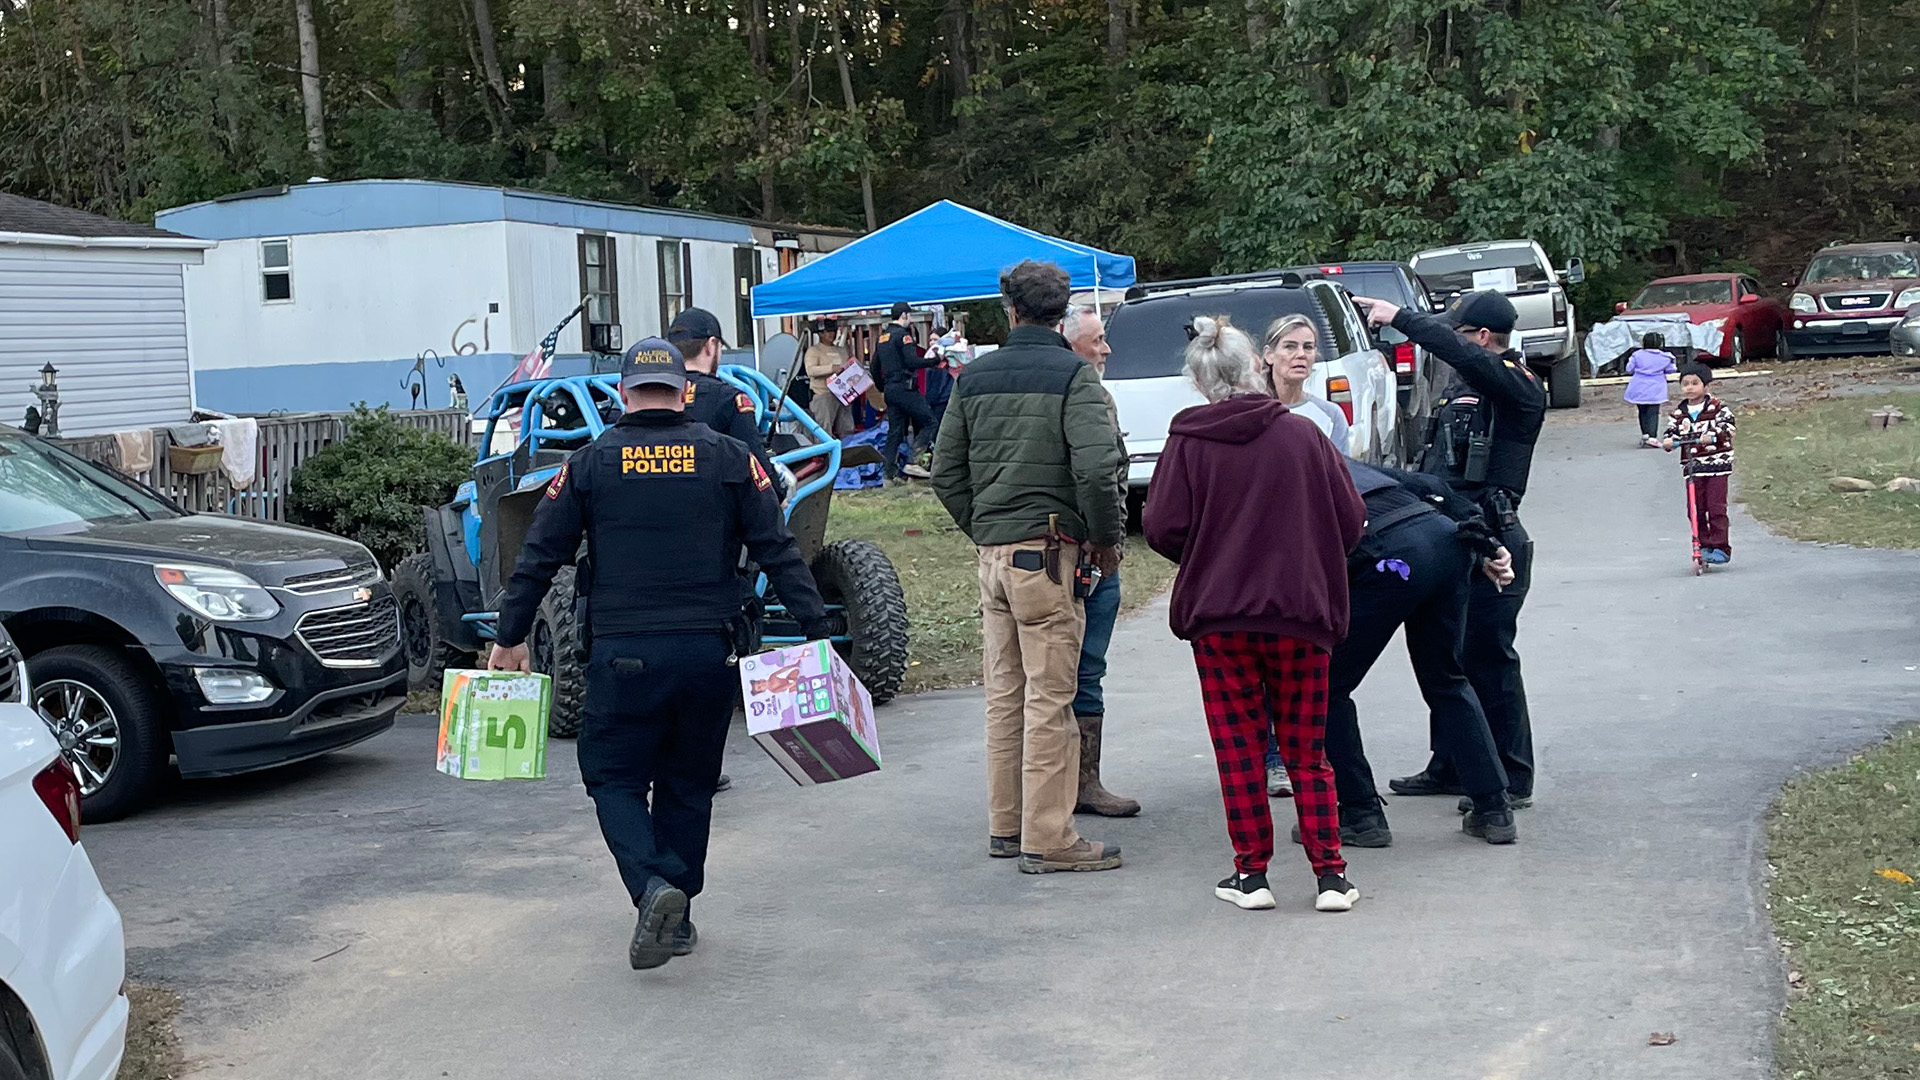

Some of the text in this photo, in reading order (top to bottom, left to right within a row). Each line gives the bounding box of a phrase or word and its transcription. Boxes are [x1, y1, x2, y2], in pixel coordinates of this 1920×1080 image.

[1841, 297, 1870, 305] GMC
[451, 317, 489, 356] 61
[634, 356, 672, 364] POLICE
[622, 445, 695, 459] RALEIGH
[622, 459, 695, 473] POLICE
[486, 715, 526, 749] 5
